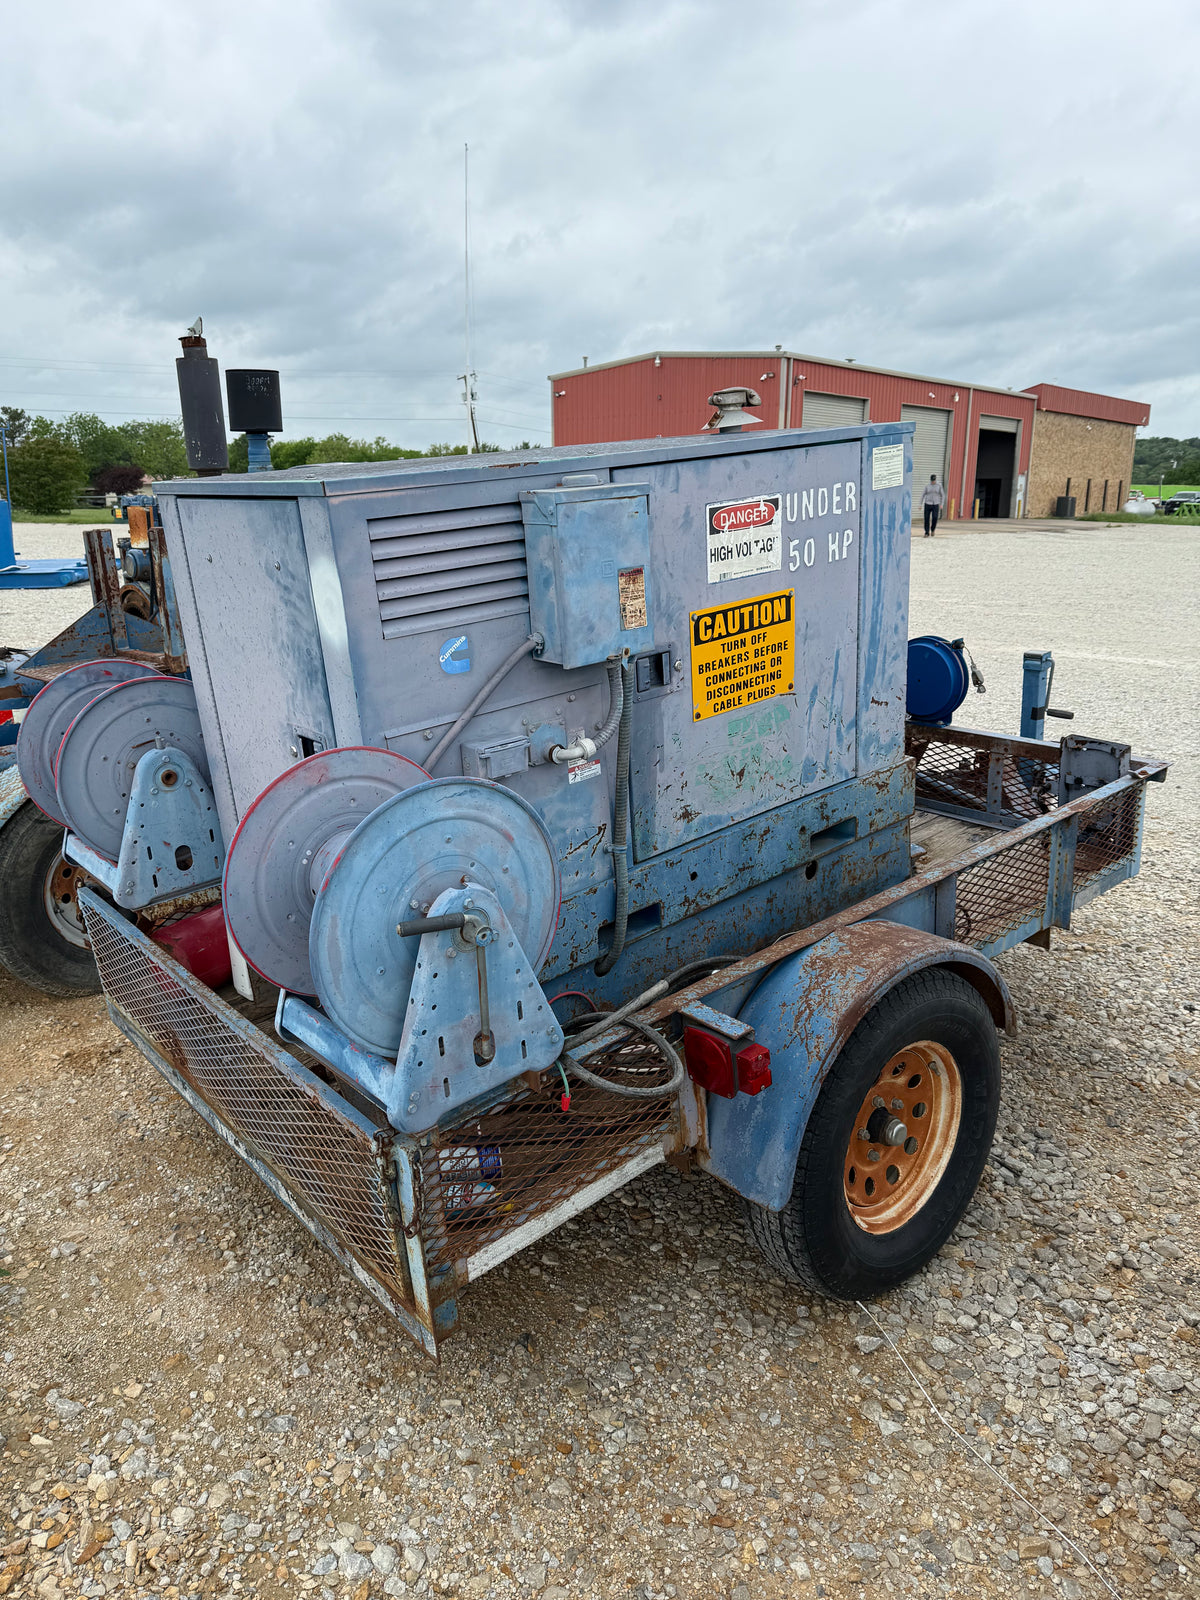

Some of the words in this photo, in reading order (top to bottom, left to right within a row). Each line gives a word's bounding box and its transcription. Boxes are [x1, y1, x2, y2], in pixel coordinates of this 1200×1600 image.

[720, 506, 769, 527] DANGER
[785, 481, 857, 522] UNDER
[709, 545, 734, 563] HIGH
[788, 537, 815, 571] 50
[827, 529, 853, 562] HP
[698, 597, 787, 641] CAUTION
[440, 635, 466, 663] Cummins
[698, 651, 749, 674] BREAKERS
[754, 640, 788, 658] BEFORE
[721, 638, 746, 653] TURN
[750, 632, 767, 645] OFF
[705, 661, 766, 687] CONNECTING
[770, 656, 782, 667] OR
[706, 670, 782, 701] DISCONNECTING
[713, 695, 743, 713] CABLE
[747, 685, 776, 702] PLUGS
